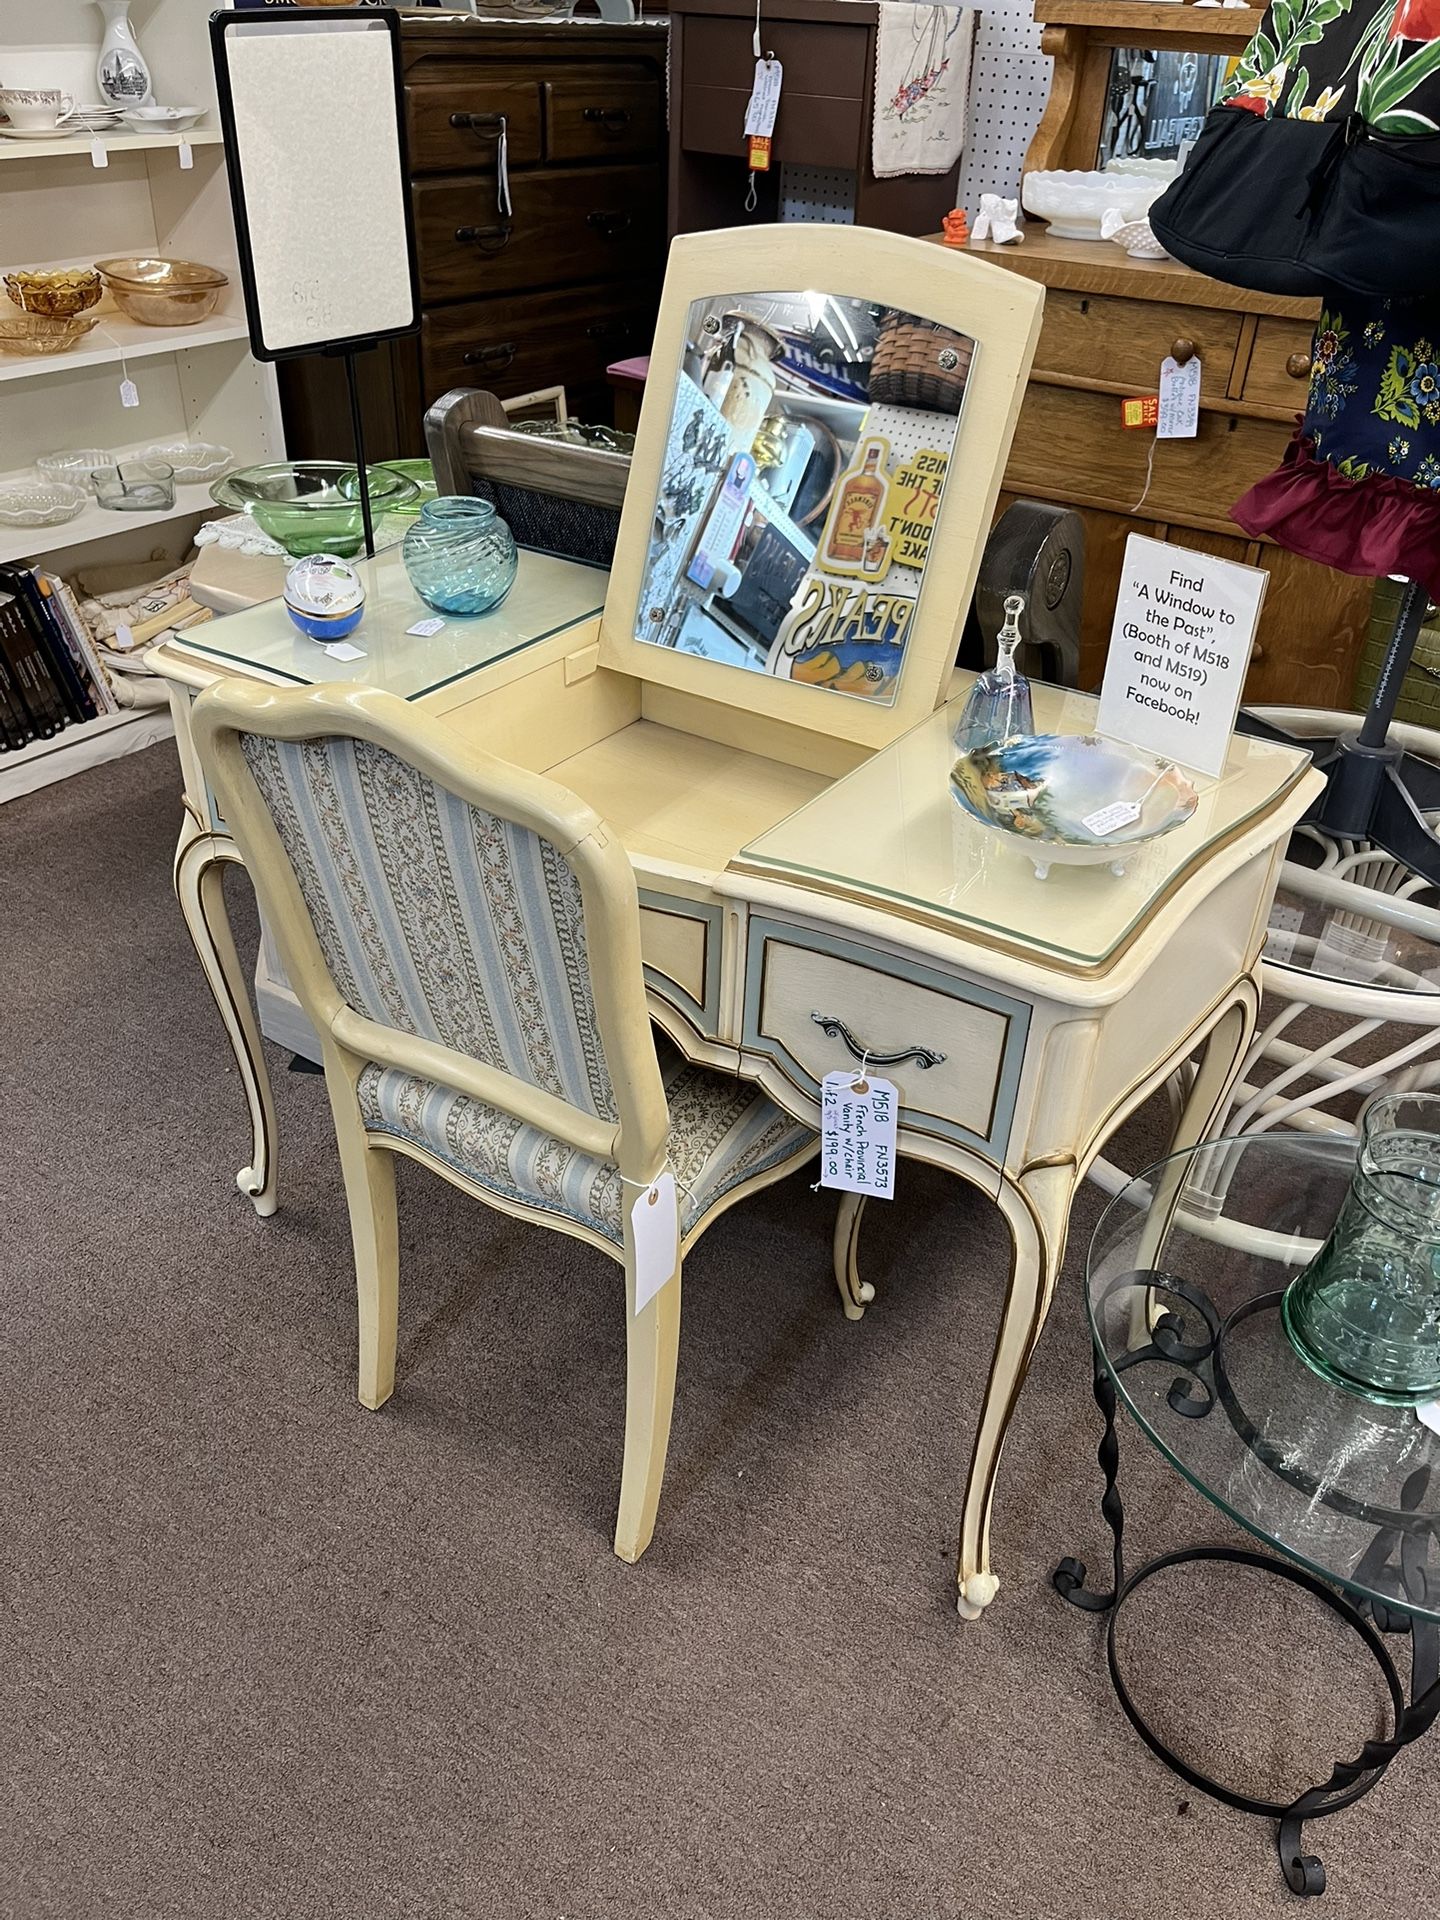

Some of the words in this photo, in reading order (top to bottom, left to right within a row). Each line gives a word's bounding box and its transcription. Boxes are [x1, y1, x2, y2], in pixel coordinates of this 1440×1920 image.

[1147, 398, 1158, 424] SALE
[1169, 570, 1204, 593] Find
[1145, 608, 1170, 628] the
[1154, 587, 1215, 619] Window
[1219, 608, 1236, 625] to
[1122, 622, 1171, 650] (Booth
[1174, 640, 1191, 656] of
[1193, 648, 1230, 670] M518
[1133, 649, 1161, 669] and
[1165, 659, 1209, 687] M519)
[1140, 673, 1171, 692] now
[1174, 685, 1193, 701] on
[1126, 686, 1201, 726] Facebook!
[839, 1102, 853, 1134] Vanity
[855, 1104, 869, 1137] French
[871, 1089, 891, 1123] M518
[824, 1130, 839, 1176] $199.00
[874, 1145, 888, 1189] FN3573
